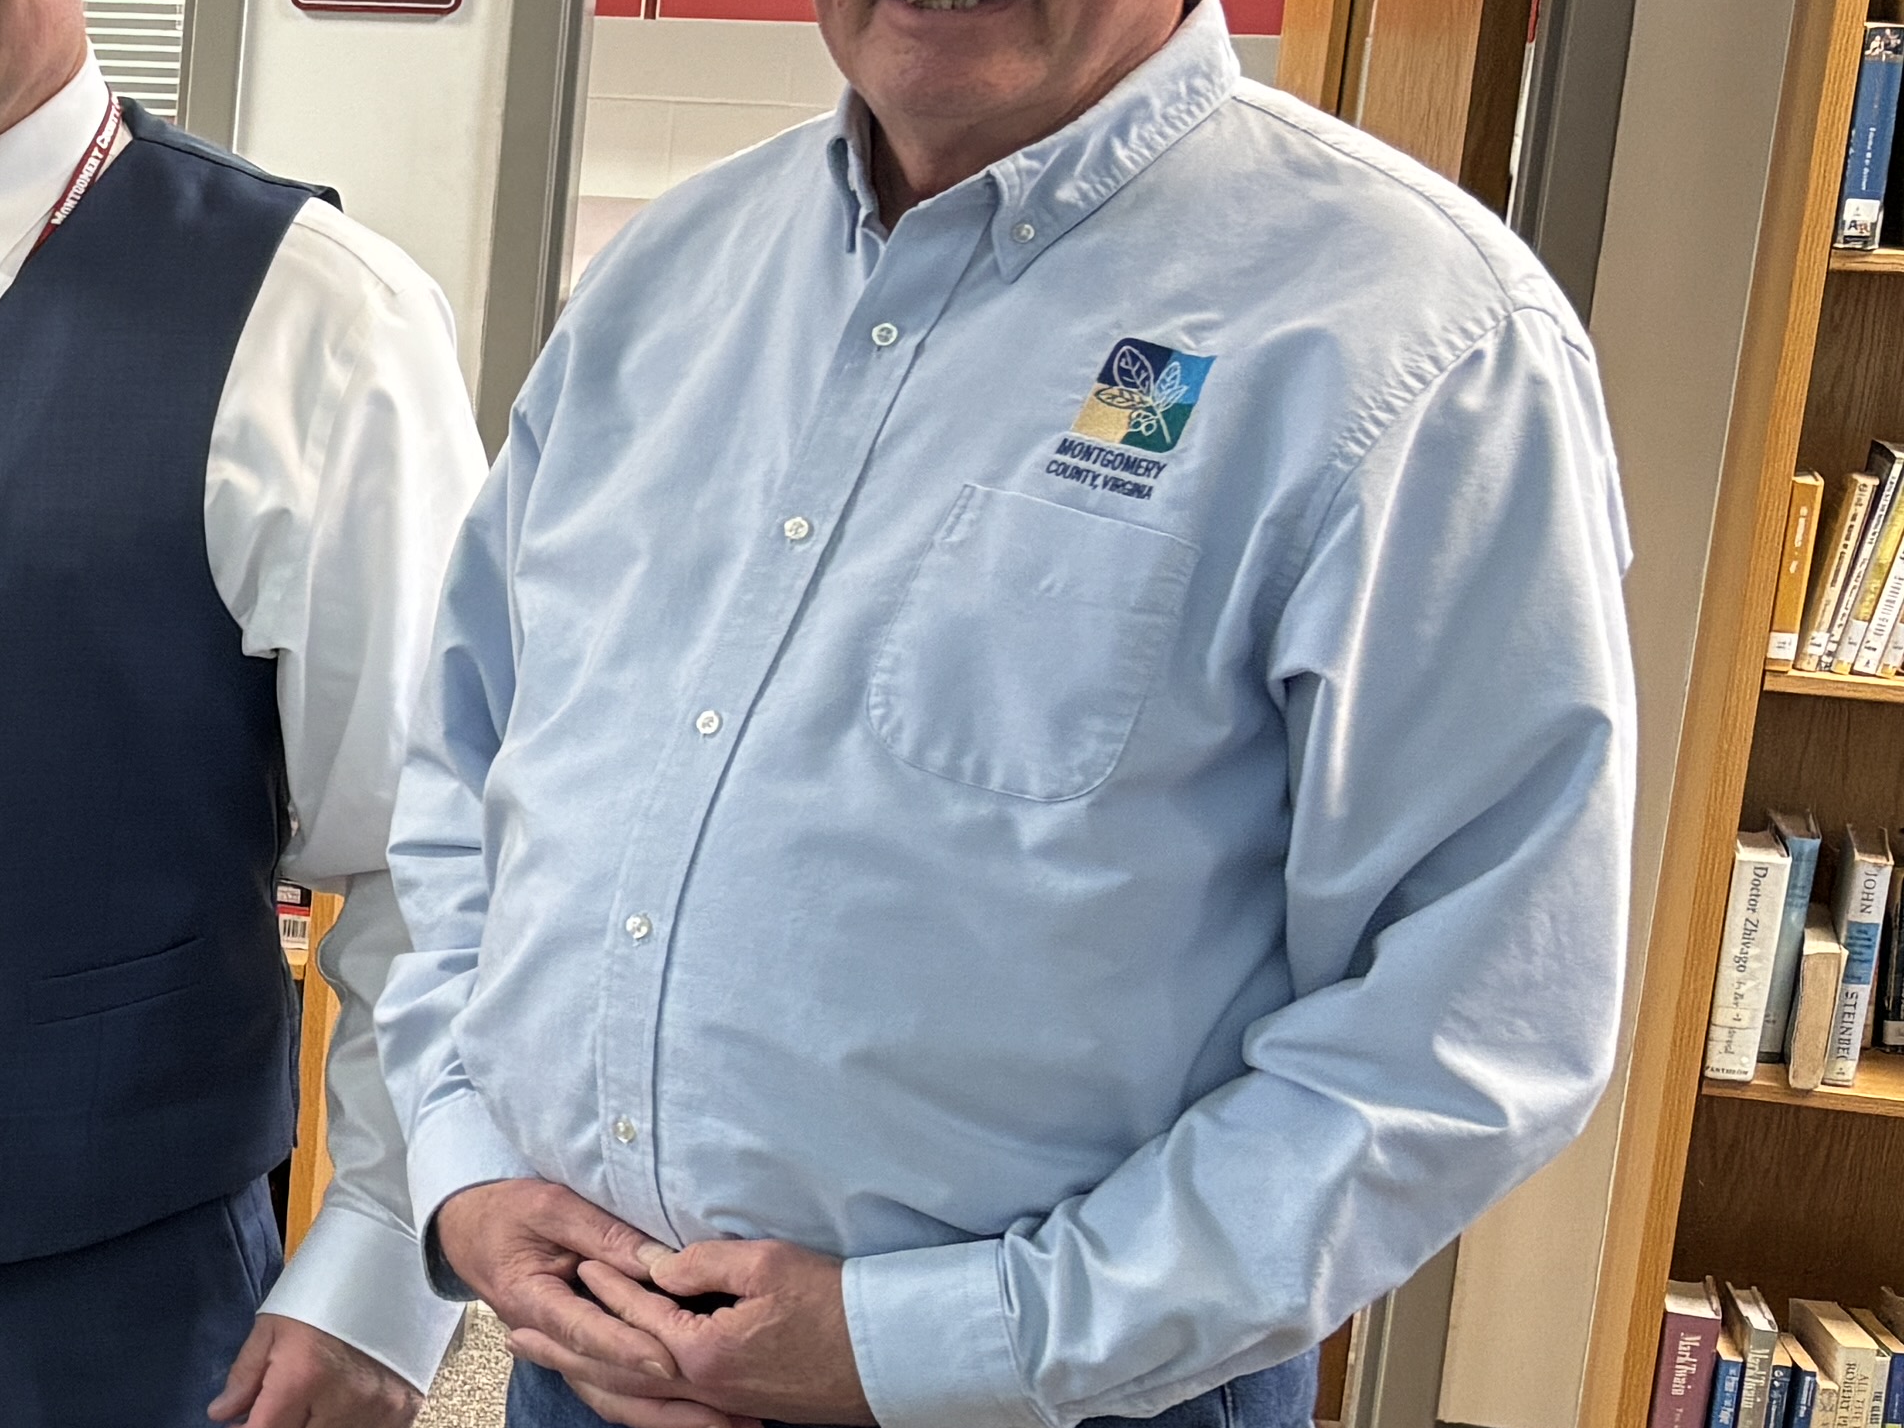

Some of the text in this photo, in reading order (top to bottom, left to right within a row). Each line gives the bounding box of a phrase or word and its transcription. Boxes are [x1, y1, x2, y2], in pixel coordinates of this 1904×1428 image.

[1054, 437, 1168, 480] MONTGOMERY
[1101, 473, 1154, 500] VIRGINIA
[1746, 864, 1770, 915] Doctor
[1859, 871, 1880, 916] JOHN
[1732, 916, 1761, 974] Zhivago
